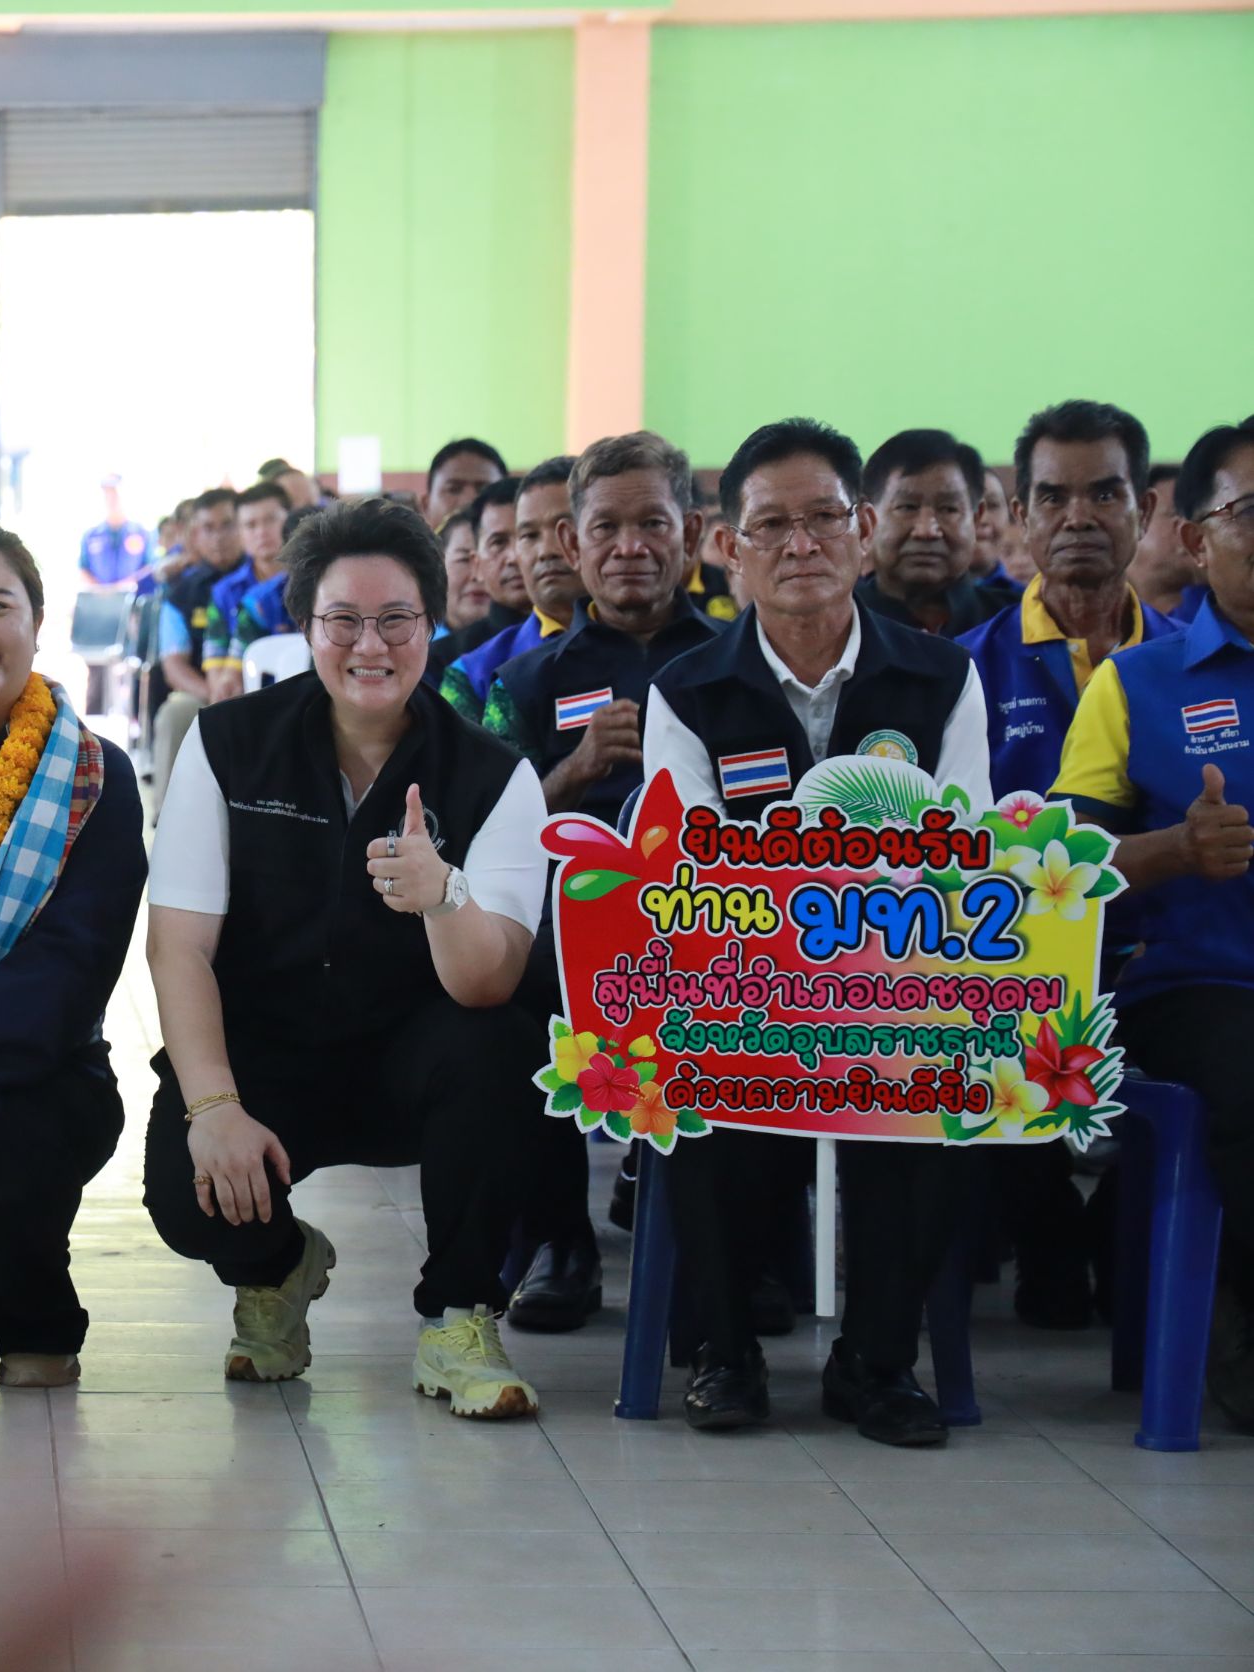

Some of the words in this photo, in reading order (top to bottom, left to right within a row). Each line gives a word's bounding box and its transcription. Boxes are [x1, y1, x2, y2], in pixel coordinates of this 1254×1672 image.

[682, 806, 994, 870] ยินดีต้อนรับ
[644, 865, 779, 934] ท่าน
[789, 878, 1025, 961] มท.2
[595, 939, 1064, 1024] สู่พื้นที่อำเภอเดชอุดม
[659, 1009, 1022, 1070] จังหวัดอุบลราชธานี
[664, 1054, 992, 1115] ด้วยความยินดียิ่ง
